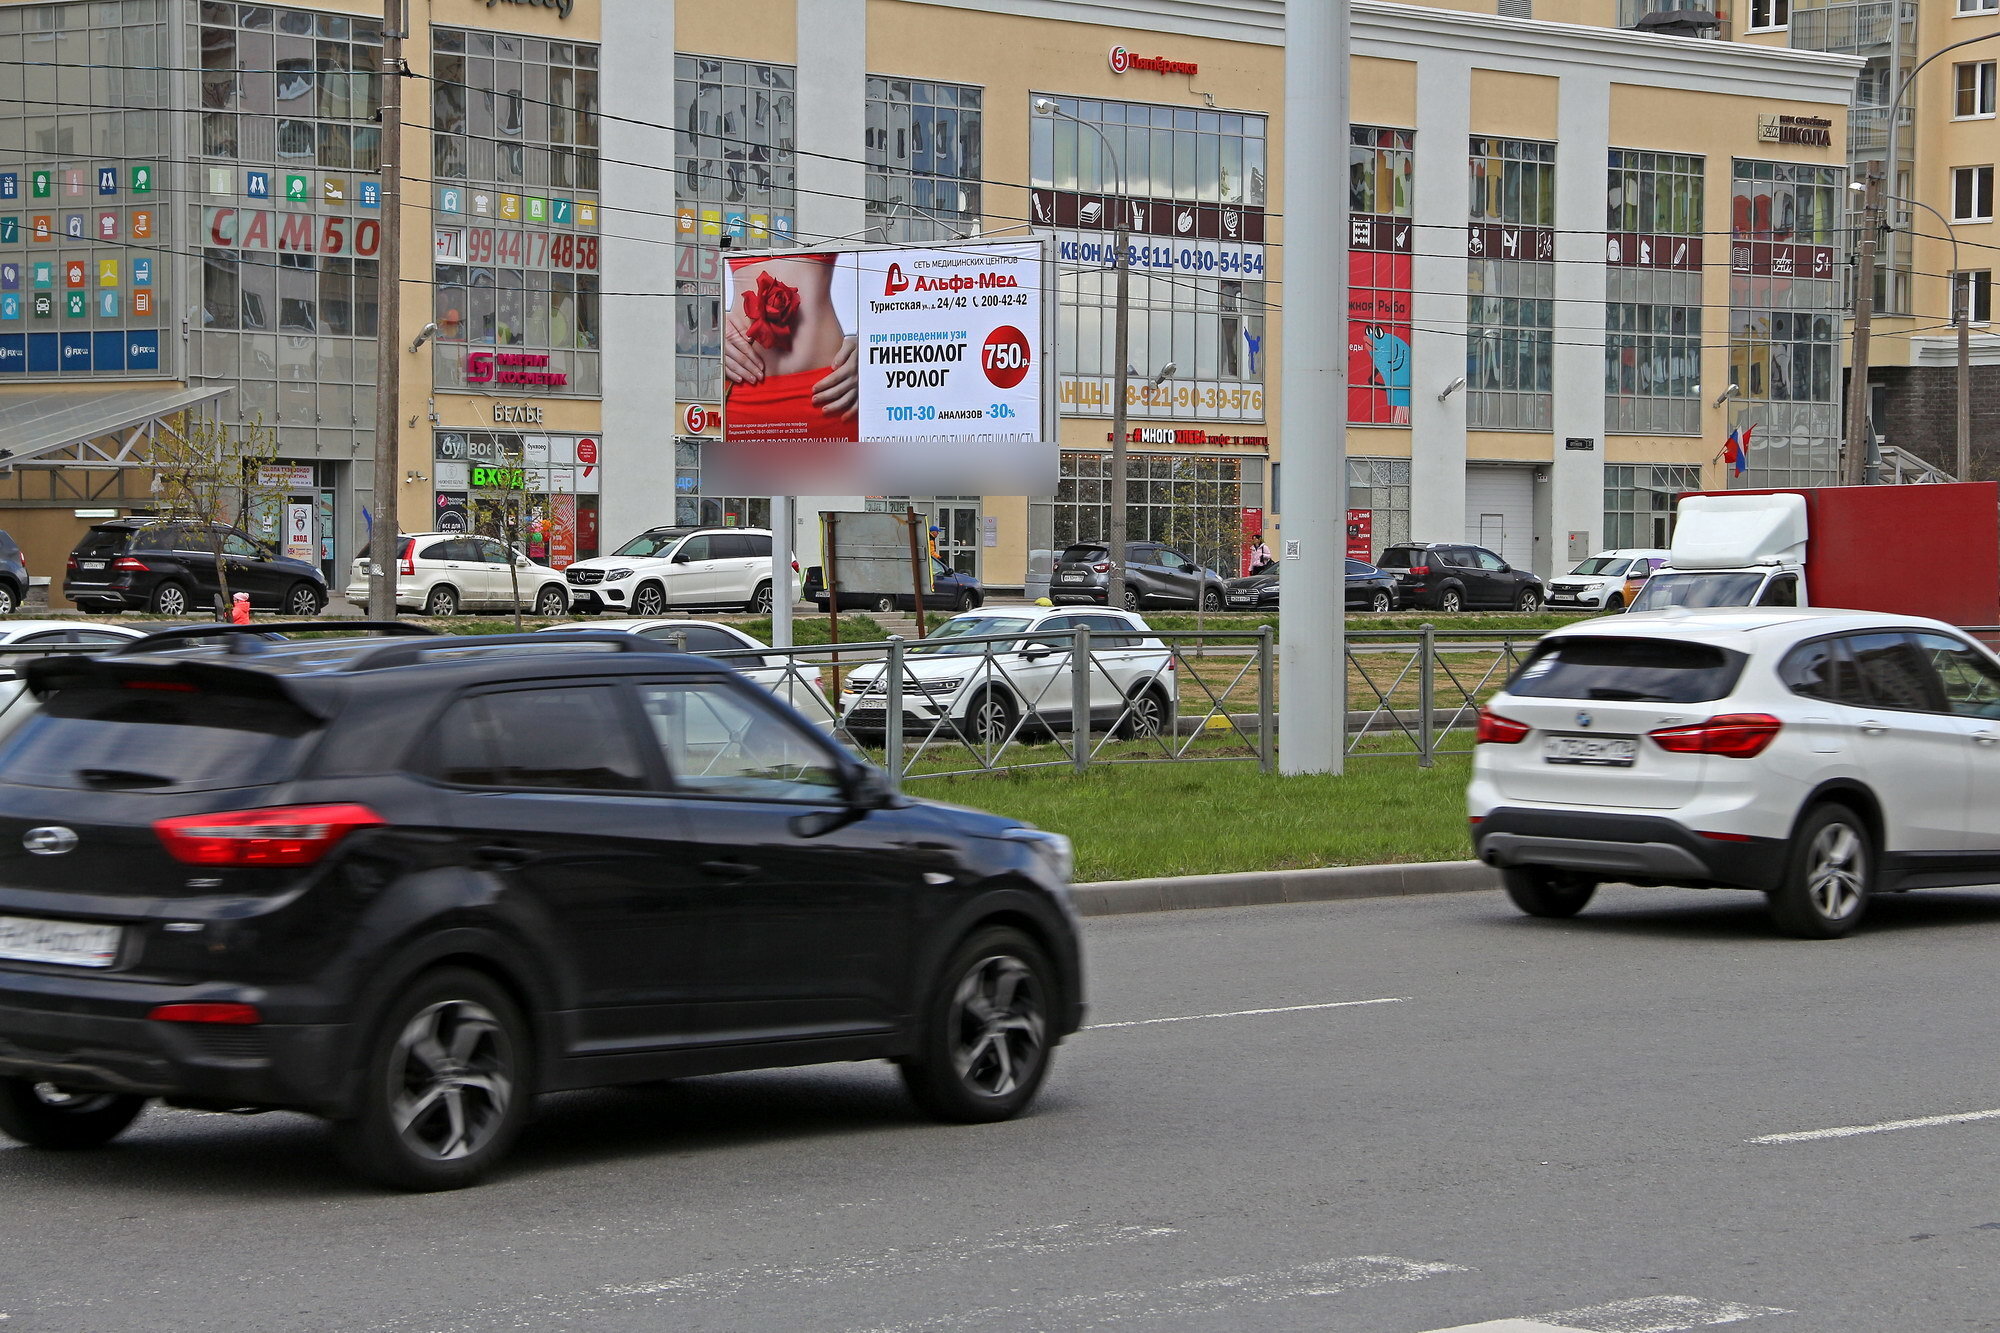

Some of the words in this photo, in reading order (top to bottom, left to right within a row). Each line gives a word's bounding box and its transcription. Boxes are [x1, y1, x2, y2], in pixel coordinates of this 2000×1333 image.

[1780, 126, 1832, 147] ШКОЛА
[211, 209, 380, 257] САМБО
[914, 260, 931, 269] СЕТЬ
[932, 258, 984, 268] МЕДИЦИНСКИХ
[985, 256, 1018, 266] ЦЕНТРОВ
[1128, 245, 1264, 274] 8-911-030-54-54
[869, 300, 921, 314] Туристская
[937, 296, 967, 311] 24/42
[981, 293, 1028, 307] 200-42-42
[1378, 300, 1405, 313] Рыба
[869, 333, 888, 345] при
[890, 331, 949, 344] проведении
[950, 329, 967, 342] узи
[497, 353, 550, 367] МАГНИТ
[869, 343, 968, 365] ГИНЕКОЛОГ
[497, 371, 568, 386] КОСМЕТИК
[886, 369, 950, 389] УРОЛОГ
[886, 405, 935, 422] ТОП-30
[937, 410, 983, 420] АНАЛИЗОВ
